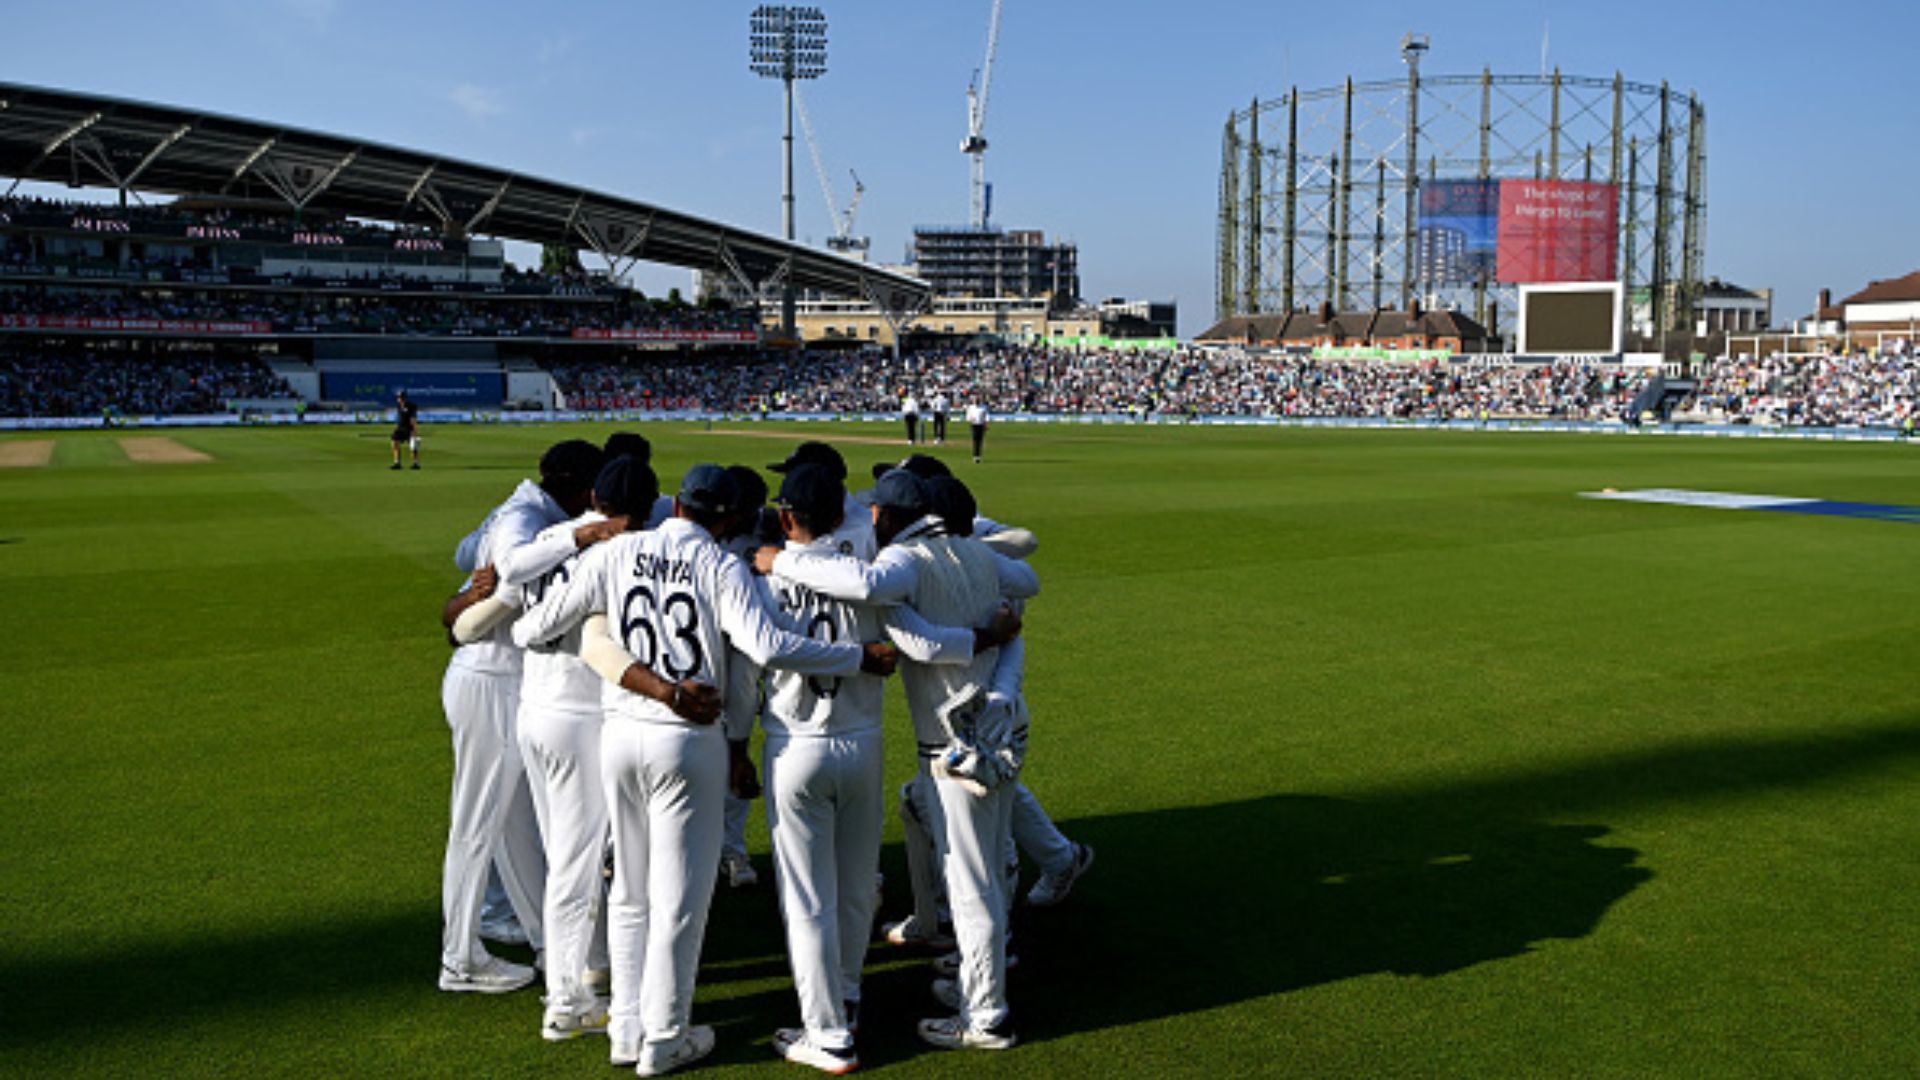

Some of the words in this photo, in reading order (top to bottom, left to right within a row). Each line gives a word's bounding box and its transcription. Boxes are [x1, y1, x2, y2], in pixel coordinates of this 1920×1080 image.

[1524, 187, 1546, 199] The
[1515, 204, 1555, 219] things
[1557, 206, 1572, 218] to
[621, 586, 701, 679] 63
